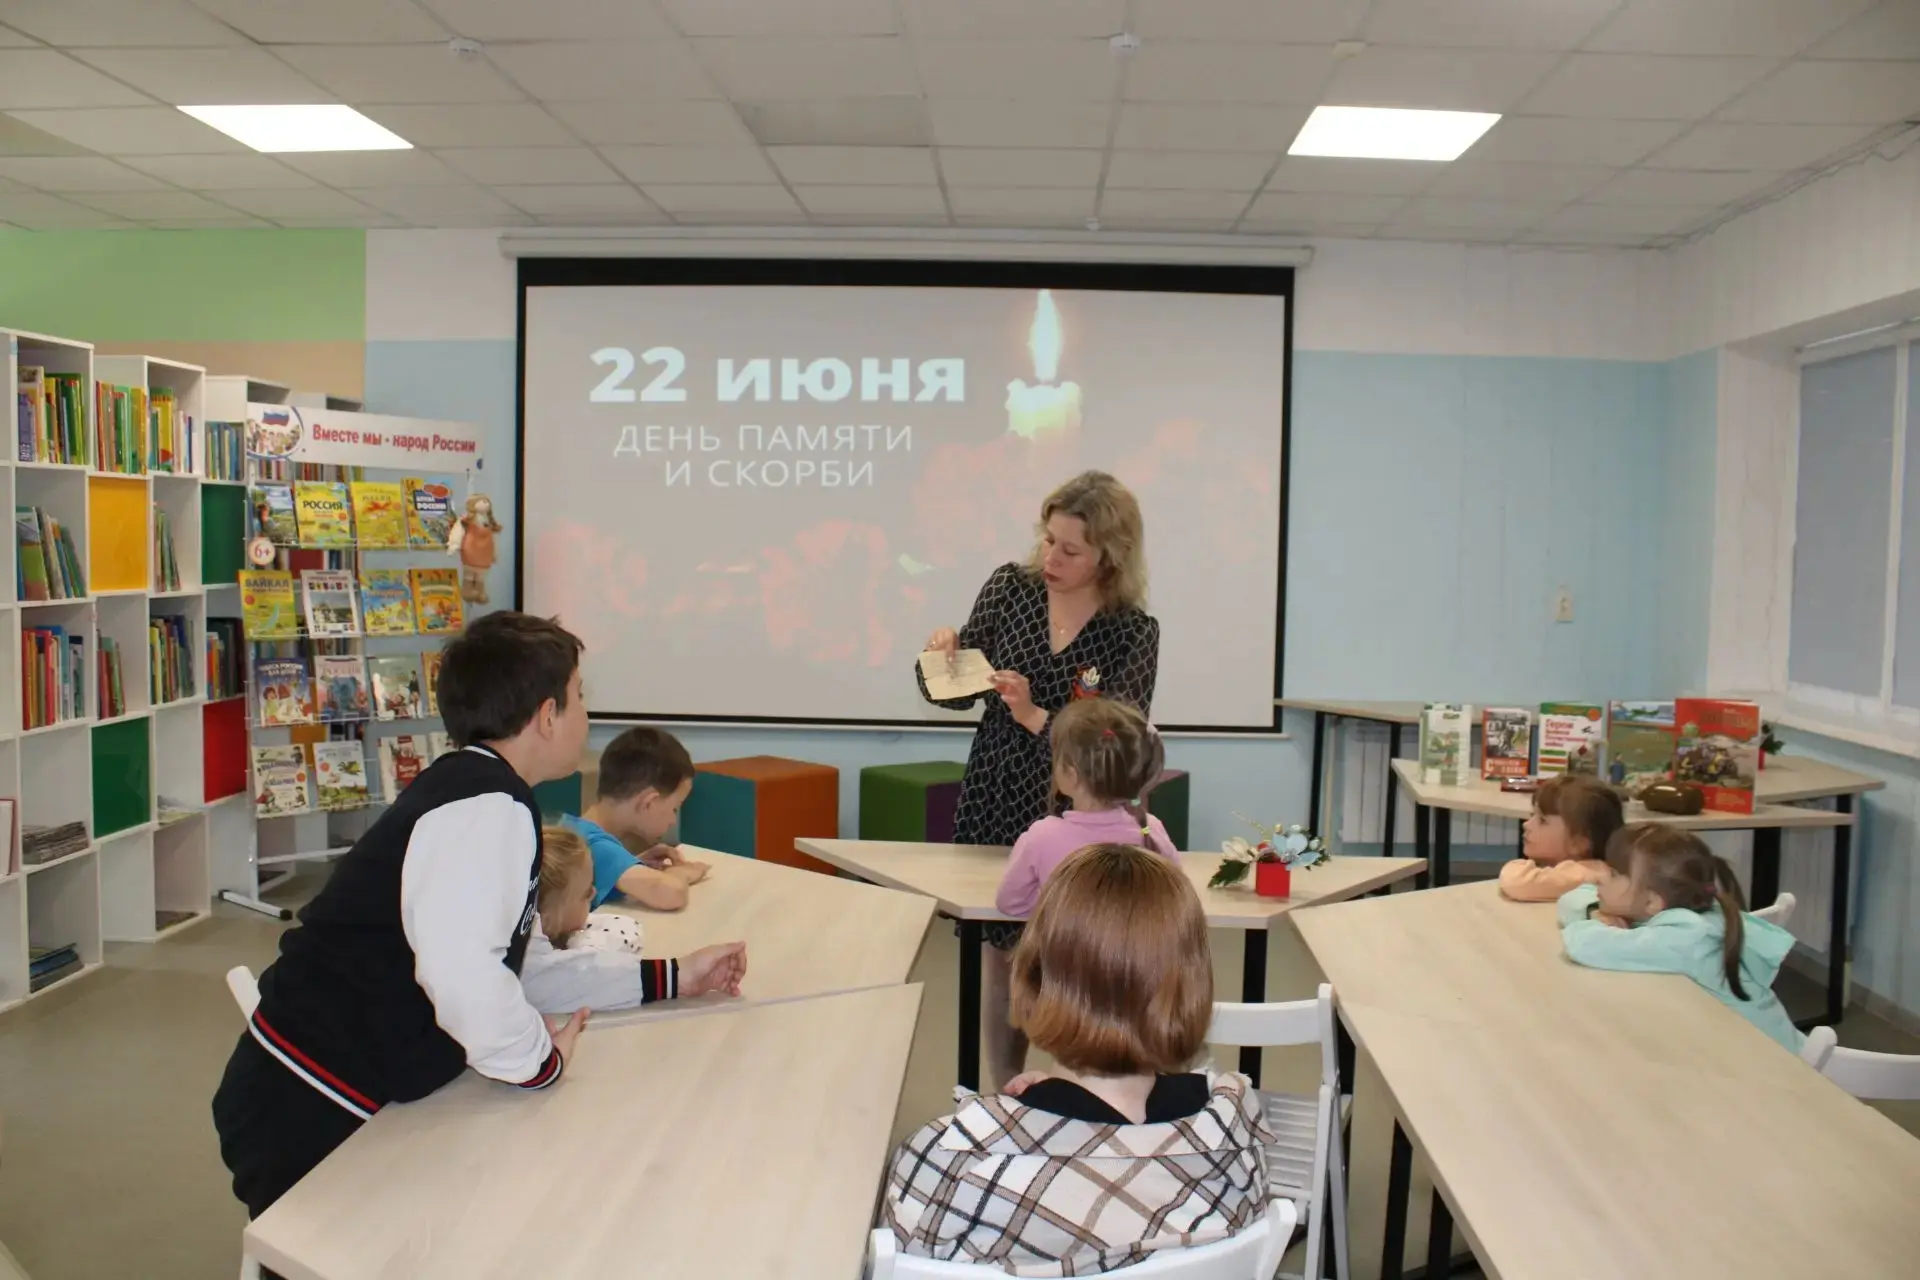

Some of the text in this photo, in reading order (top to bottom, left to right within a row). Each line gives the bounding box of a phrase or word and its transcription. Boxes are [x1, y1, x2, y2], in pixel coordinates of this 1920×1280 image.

[589, 346, 687, 403] 22
[312, 424, 359, 444] Вместе
[363, 431, 382, 446] мы
[392, 434, 429, 452] народ
[432, 434, 476, 453] России
[613, 425, 912, 457] ДЕНЬ ПАМЯТИ
[665, 460, 874, 487] И СКОРБИ
[303, 500, 343, 510] РОССИЯ
